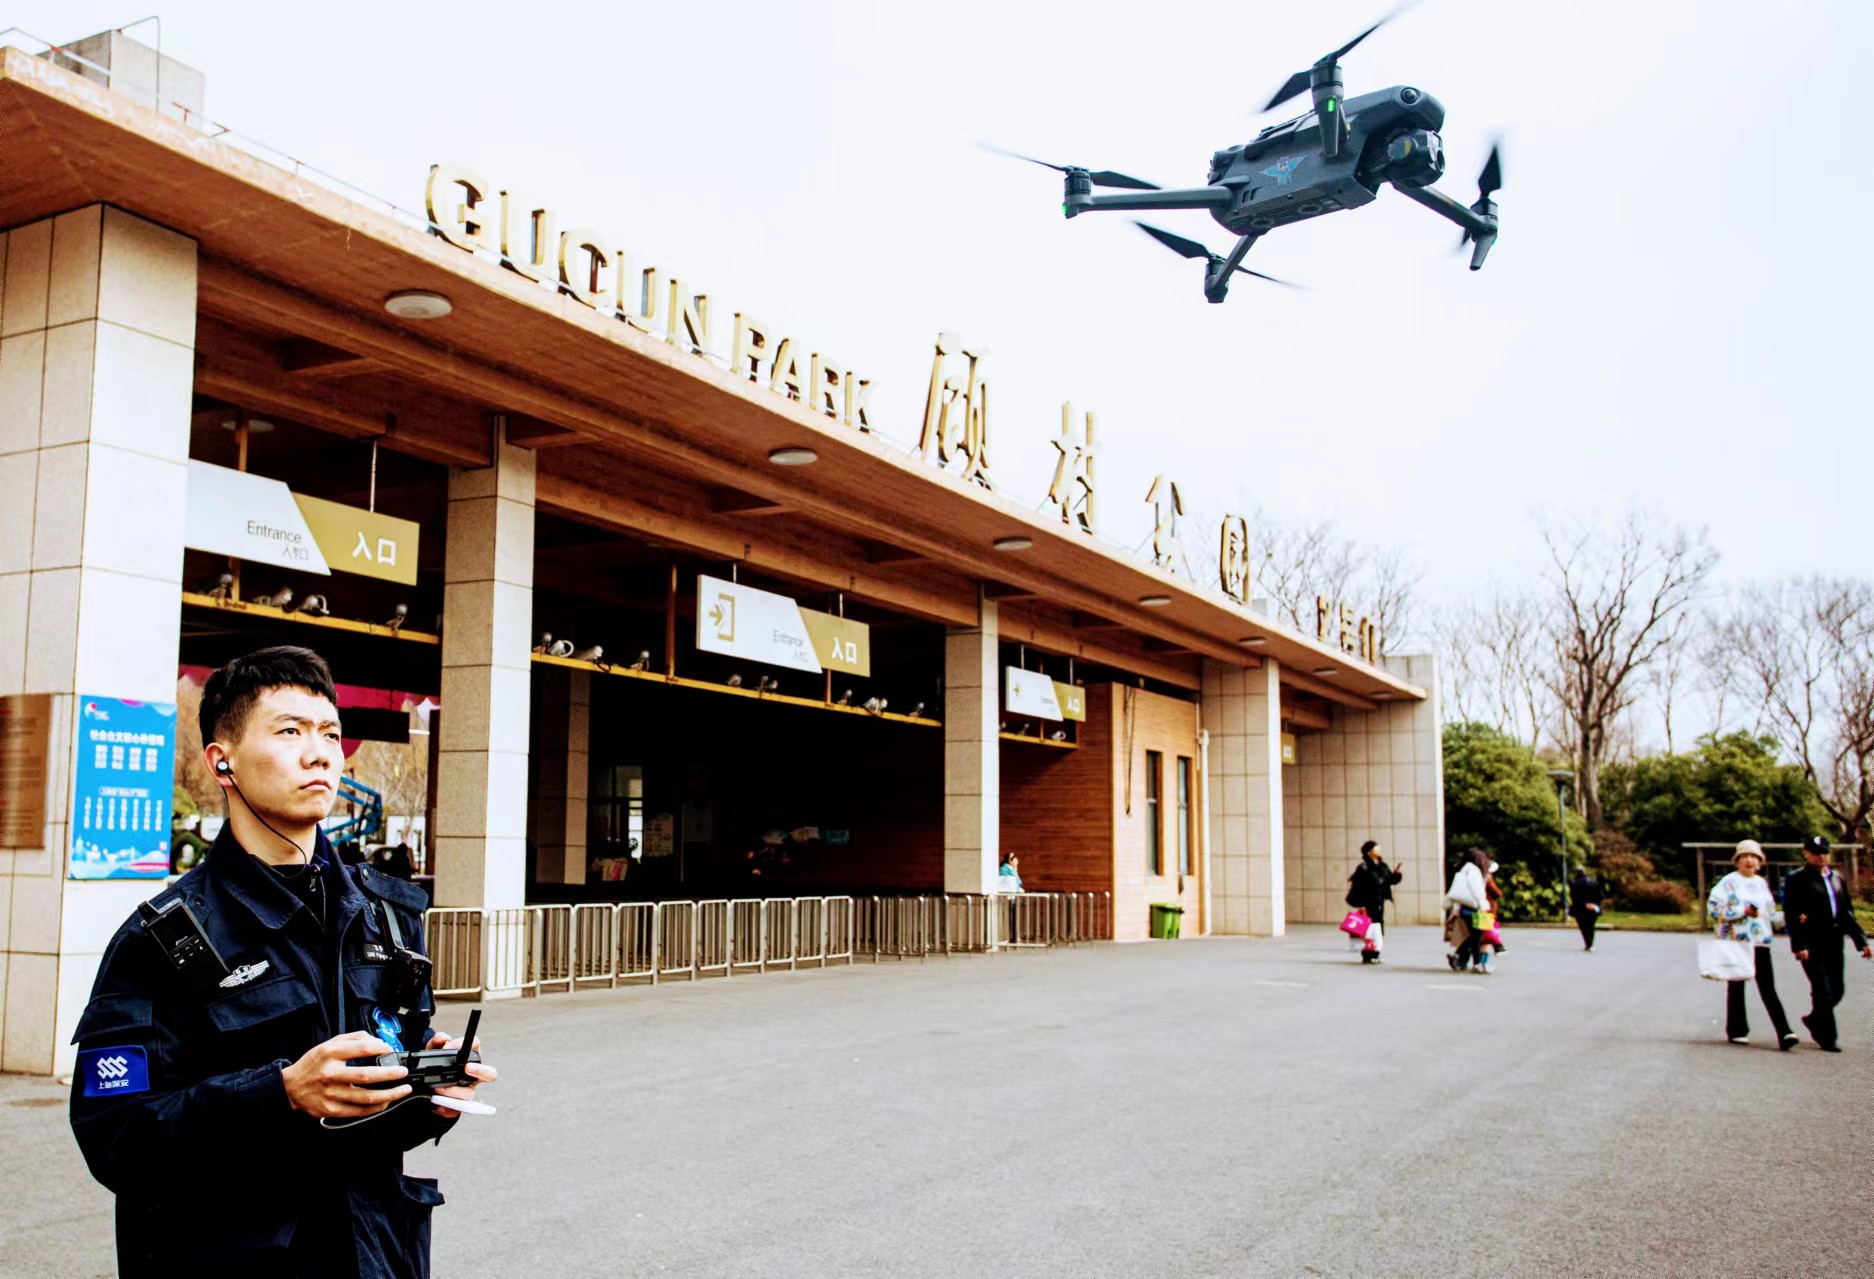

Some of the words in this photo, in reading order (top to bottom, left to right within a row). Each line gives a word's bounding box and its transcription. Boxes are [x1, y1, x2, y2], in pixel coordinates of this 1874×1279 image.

[425, 163, 714, 357] GUCUN
[730, 311, 877, 433] PARK
[246, 519, 303, 545] Entrance
[352, 531, 397, 567] 入口
[831, 636, 858, 665] 入口
